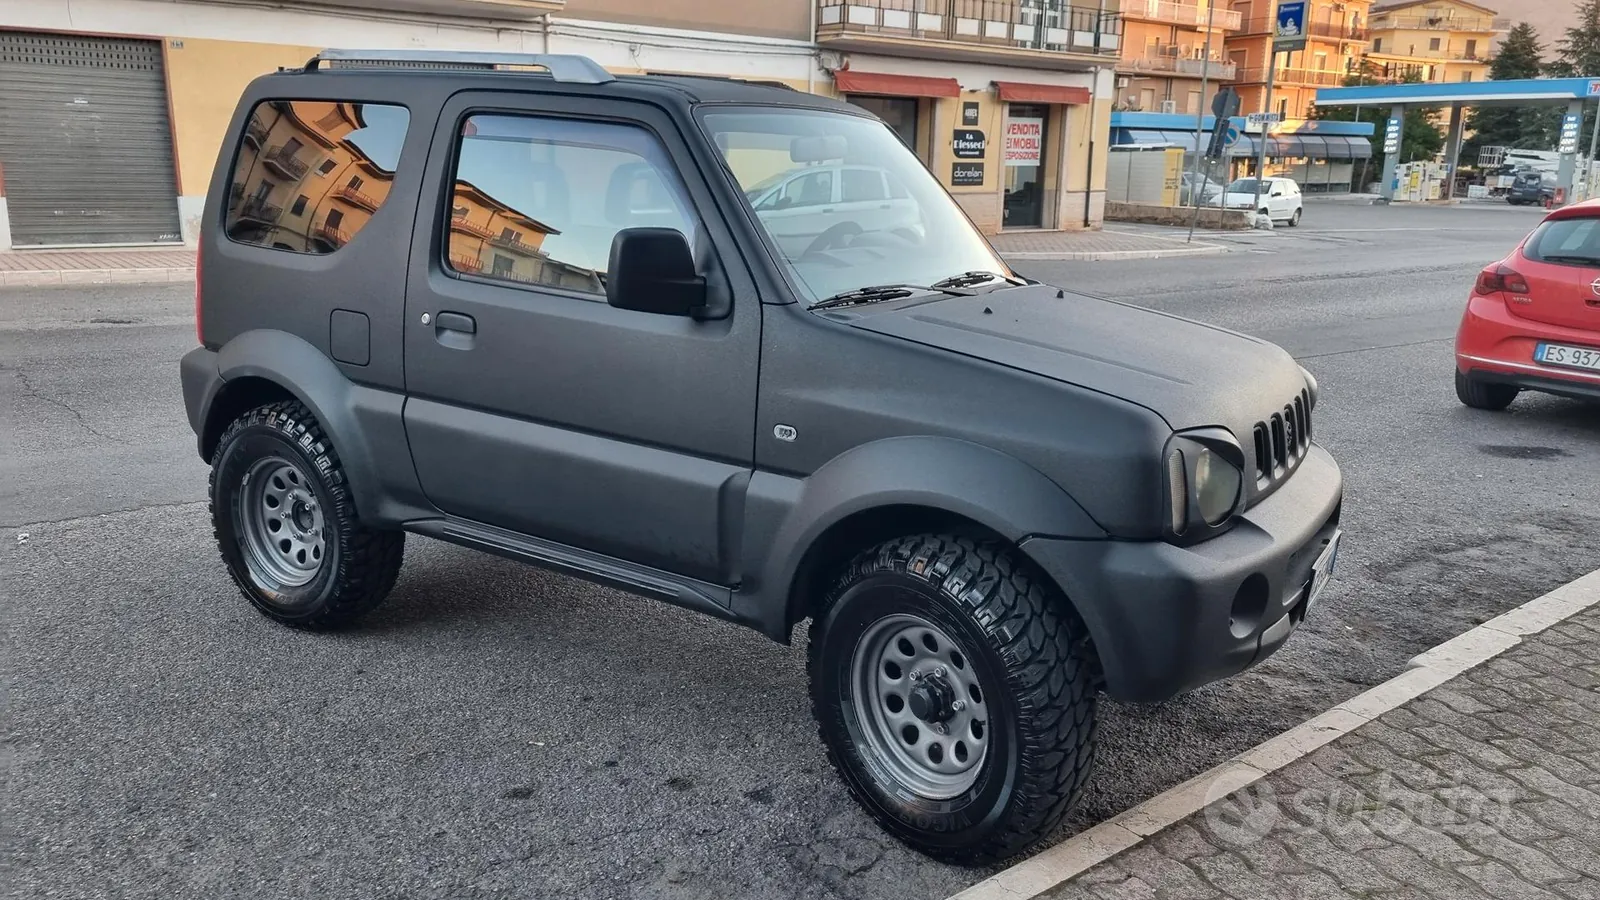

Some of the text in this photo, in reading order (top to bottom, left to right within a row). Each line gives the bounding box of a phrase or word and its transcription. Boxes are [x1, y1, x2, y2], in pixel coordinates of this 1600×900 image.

[954, 167, 982, 178] dorelan
[1547, 347, 1566, 362] ES
[1572, 350, 1600, 367] 937
